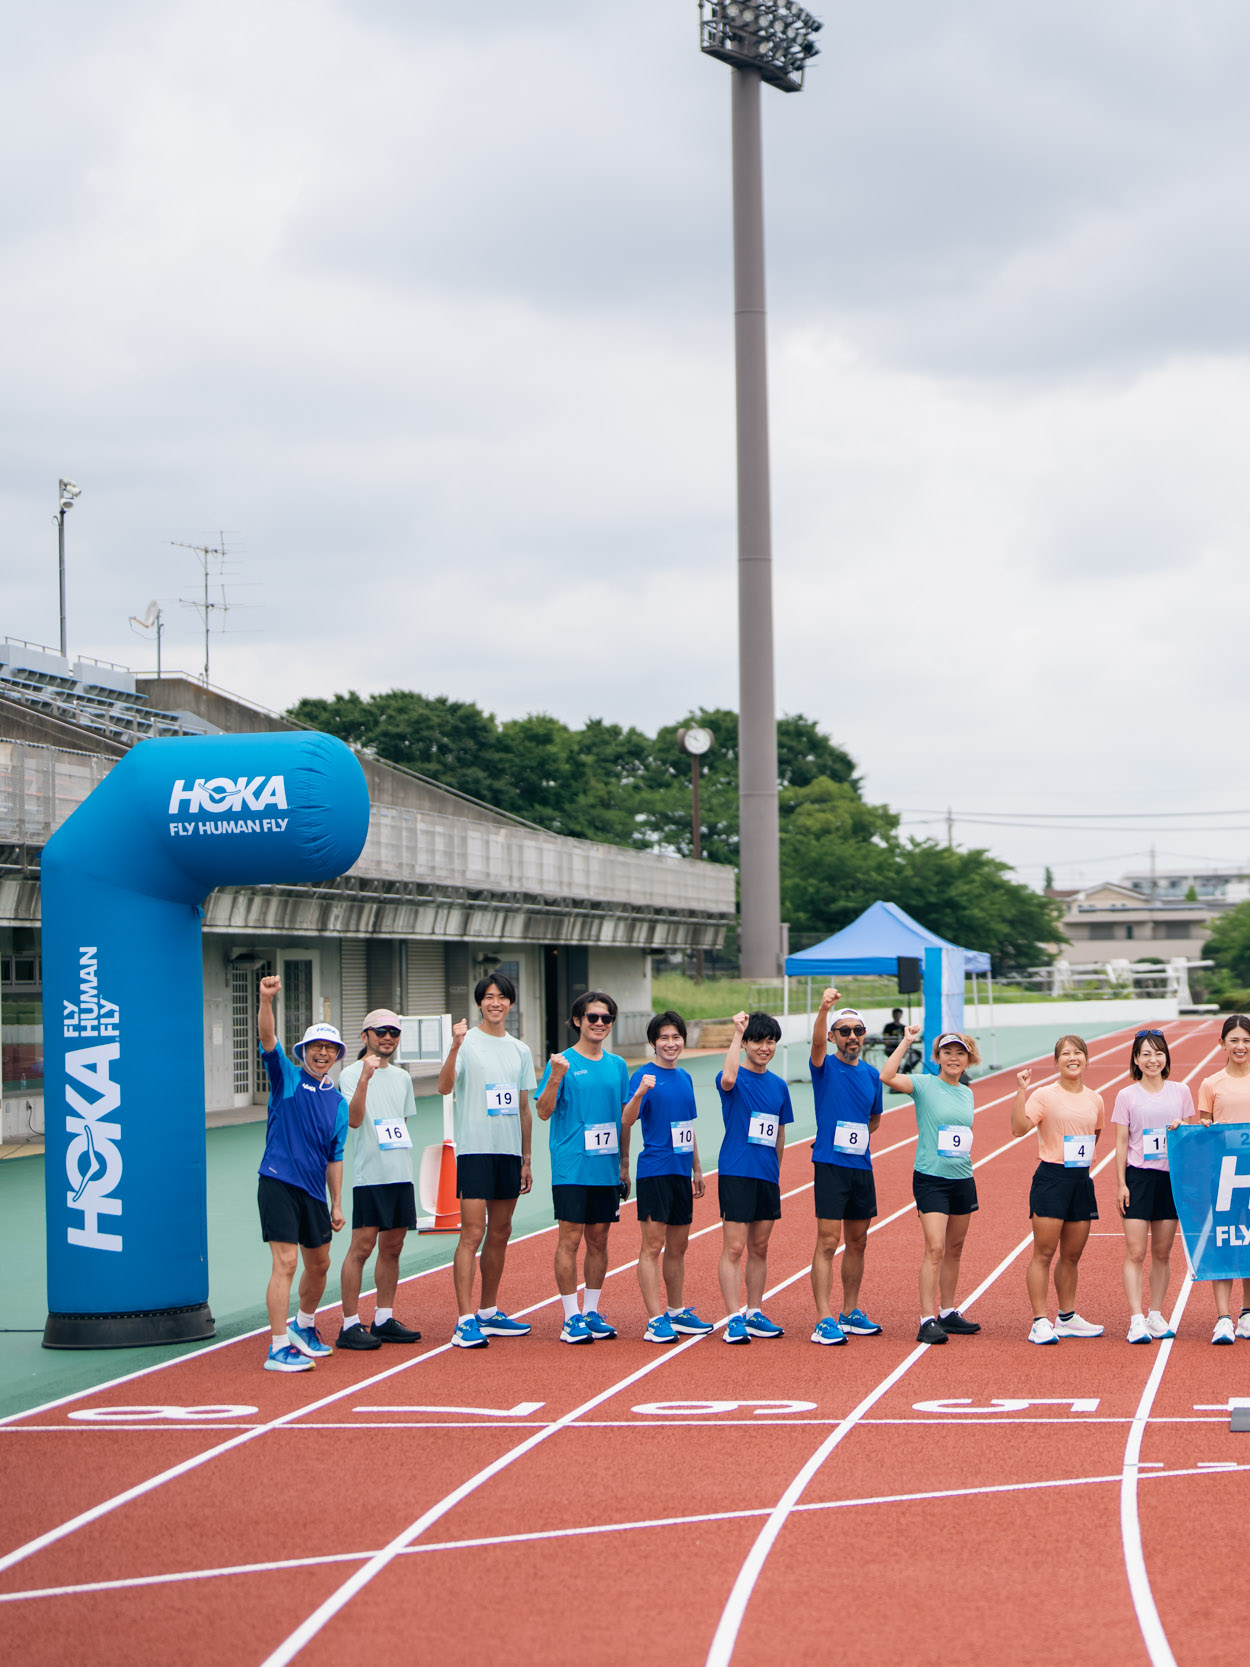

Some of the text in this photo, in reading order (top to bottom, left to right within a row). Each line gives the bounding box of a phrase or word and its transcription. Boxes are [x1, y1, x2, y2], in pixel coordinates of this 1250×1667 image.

[168, 775, 288, 814] HOKA
[169, 818, 289, 836] FLY HUMAN FLY
[79, 946, 98, 1037] HUMAN
[63, 999, 79, 1037] FLY
[100, 998, 120, 1037] FLY
[495, 1092, 512, 1105] 19
[385, 1127, 402, 1139] 16
[679, 1130, 692, 1143] 10
[759, 1122, 774, 1136] 18
[594, 1132, 611, 1146] 17
[849, 1132, 858, 1145] 8
[953, 1135, 961, 1147] 9
[1240, 1132, 1250, 1146] 2
[65, 1042, 123, 1252] HOKA
[1077, 1145, 1085, 1157] 4
[67, 1404, 259, 1421] 8
[352, 1401, 546, 1417] 7
[631, 1400, 818, 1415] 6
[912, 1398, 1101, 1414] 5
